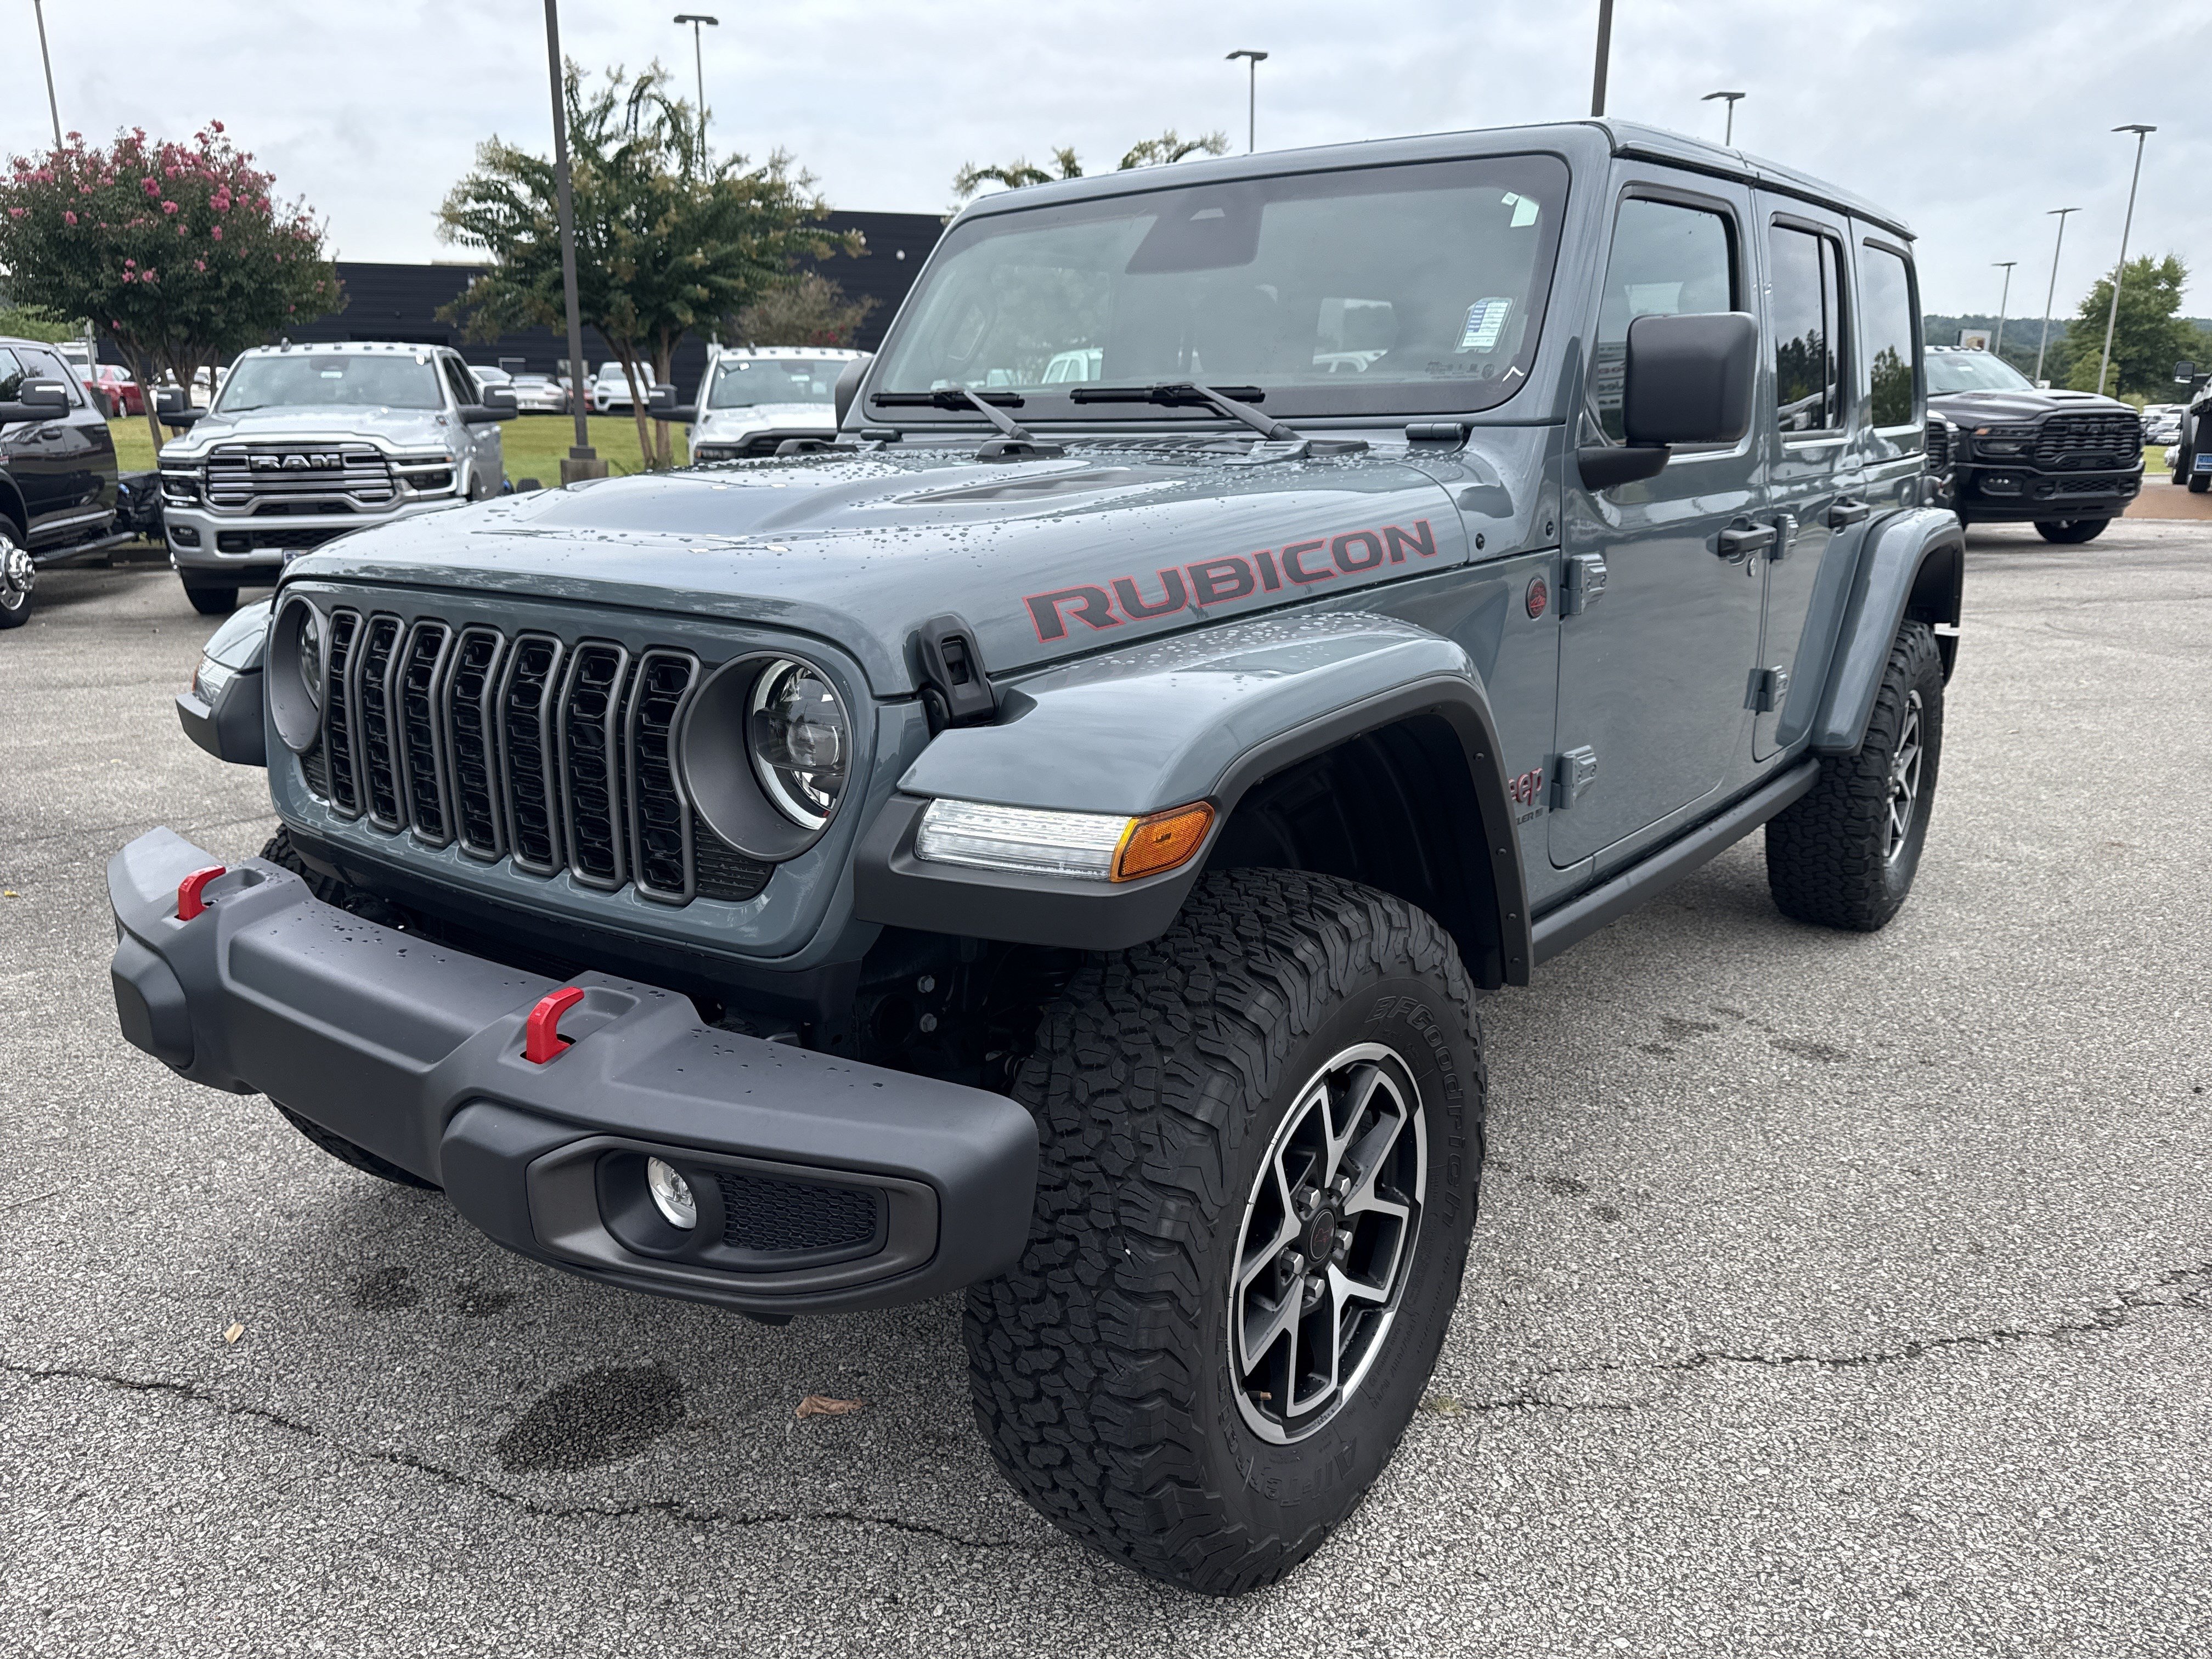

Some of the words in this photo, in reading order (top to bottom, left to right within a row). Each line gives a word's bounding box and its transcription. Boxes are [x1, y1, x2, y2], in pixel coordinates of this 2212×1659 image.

[250, 454, 341, 469] RAM
[1022, 520, 1437, 644] RUBICON
[1508, 768, 1543, 806] eep
[1364, 996, 1465, 1228] BFGoodrich
